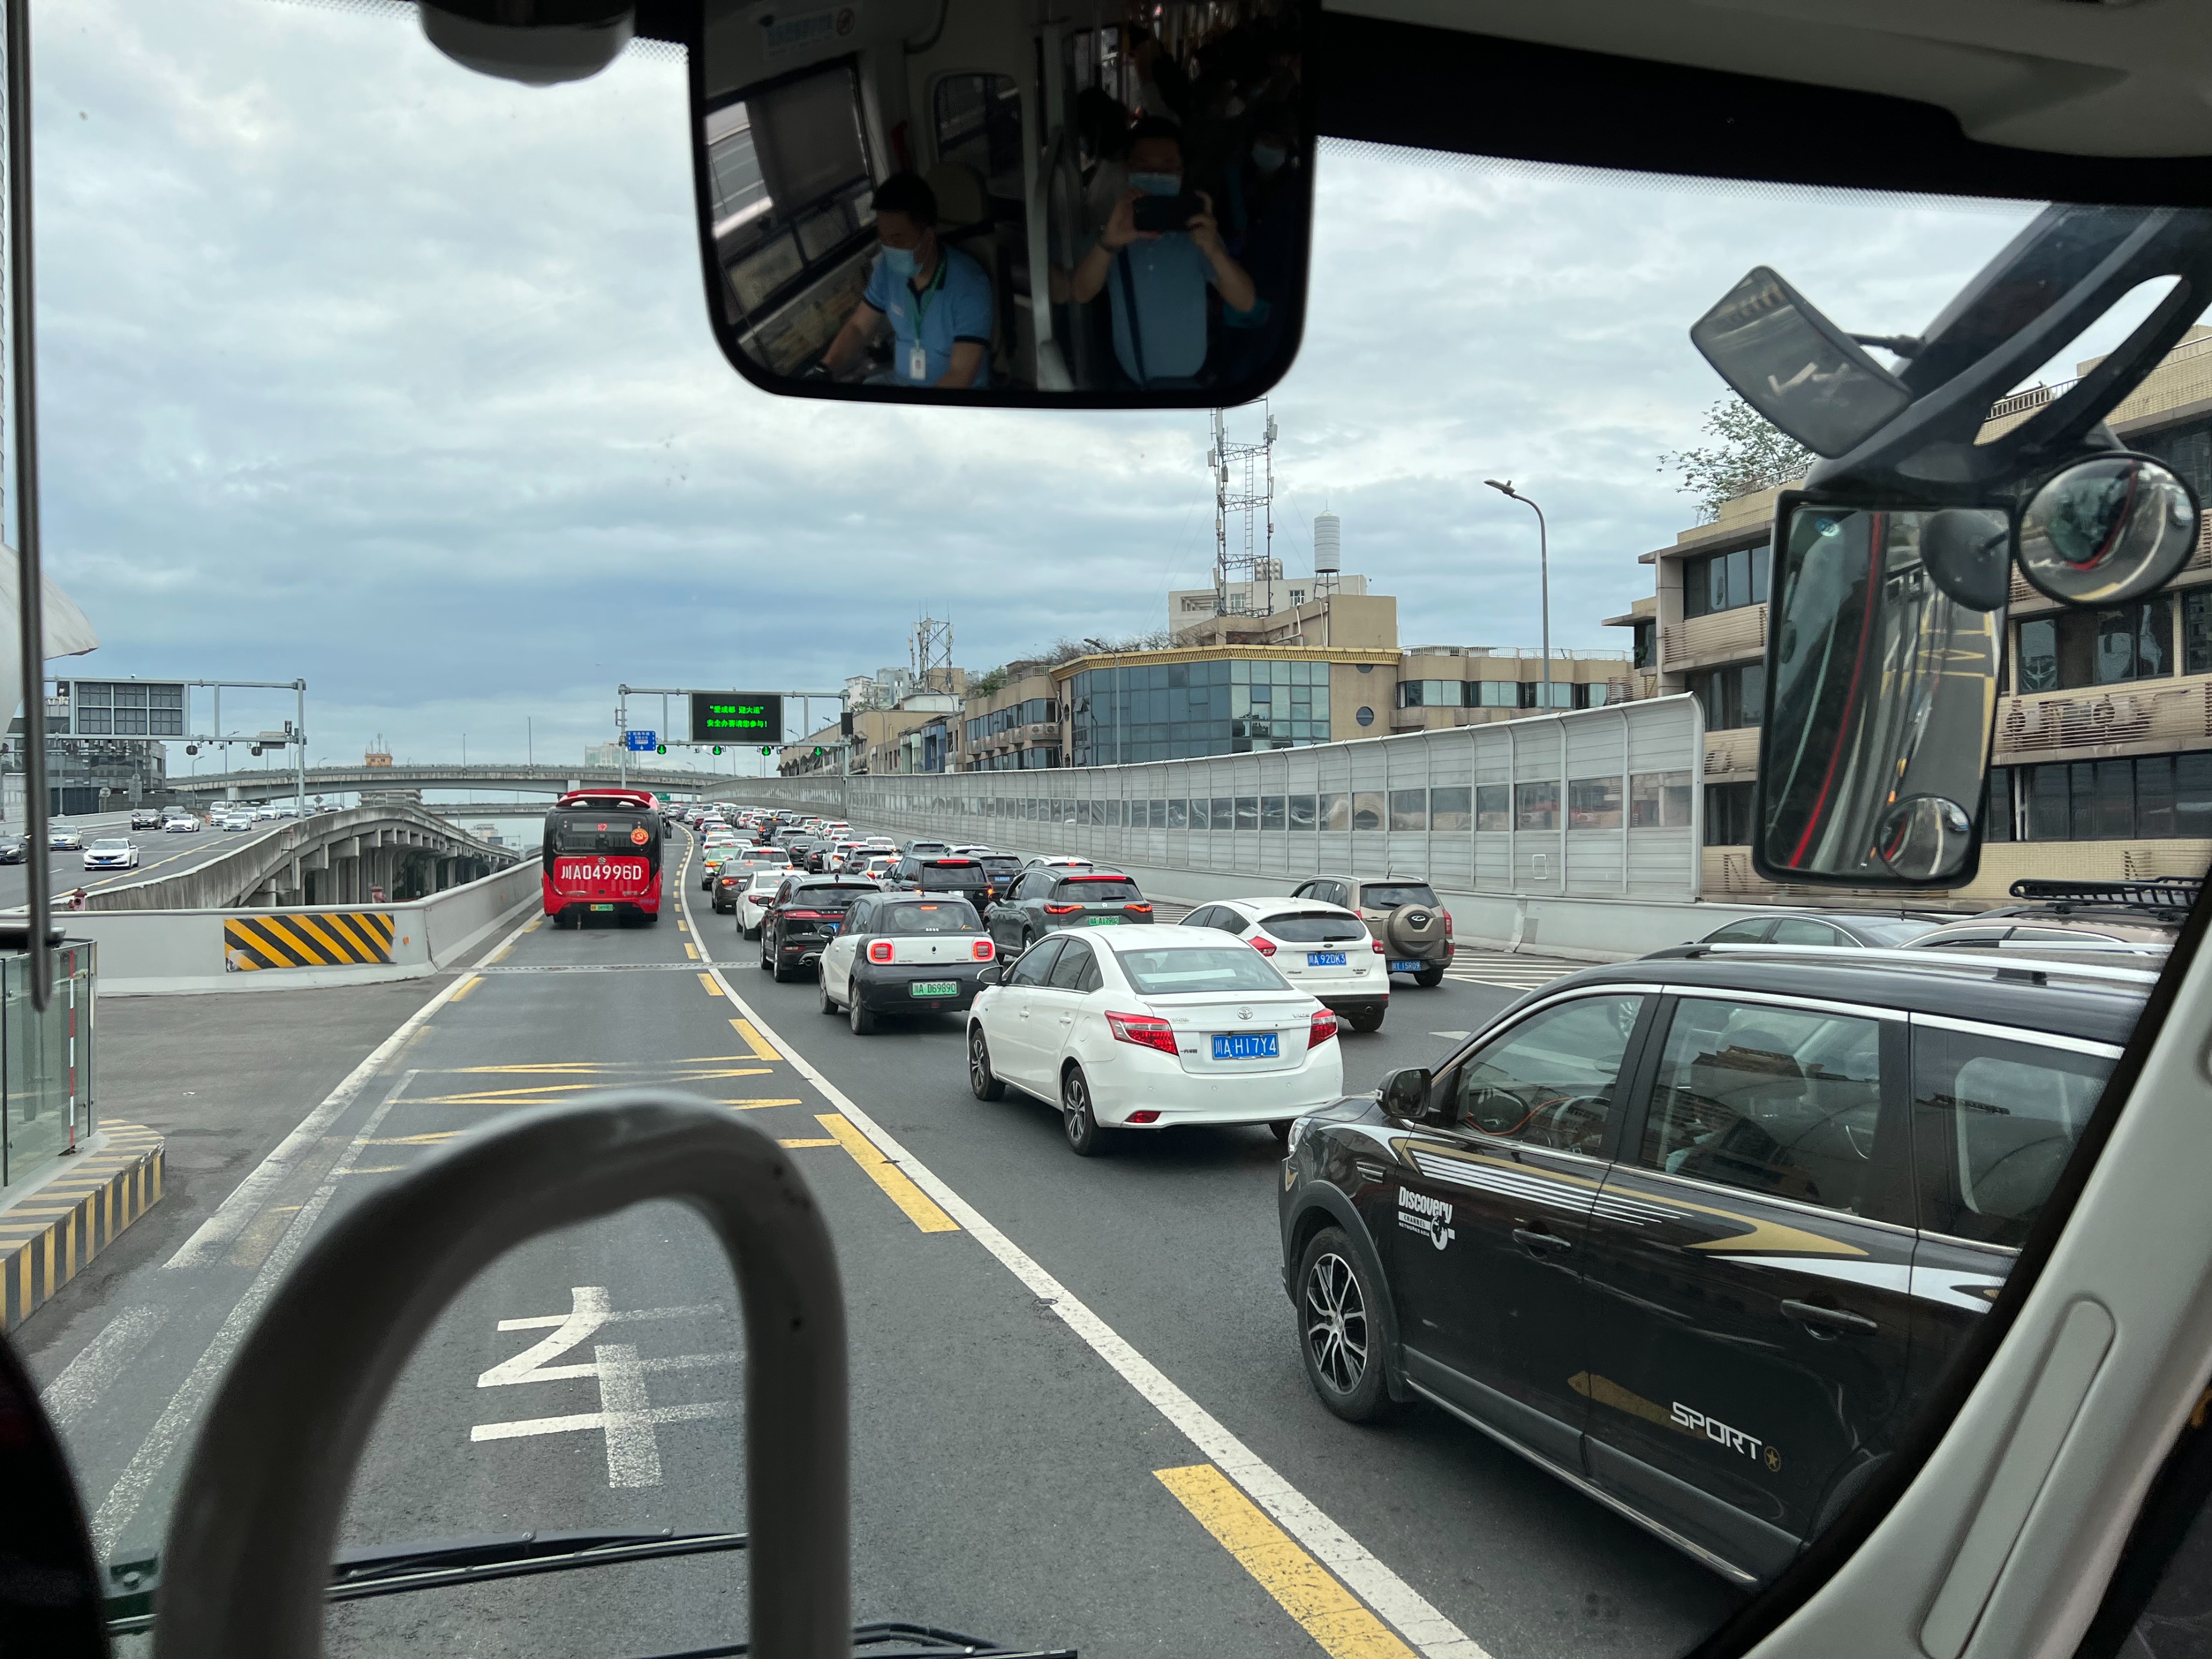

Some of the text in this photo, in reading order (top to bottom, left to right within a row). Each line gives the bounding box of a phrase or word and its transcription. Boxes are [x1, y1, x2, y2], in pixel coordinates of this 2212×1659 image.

[561, 864, 642, 880] 川A04996D
[1404, 1214, 1426, 1228] CHANNEL
[1671, 1402, 1762, 1460] SPORT
